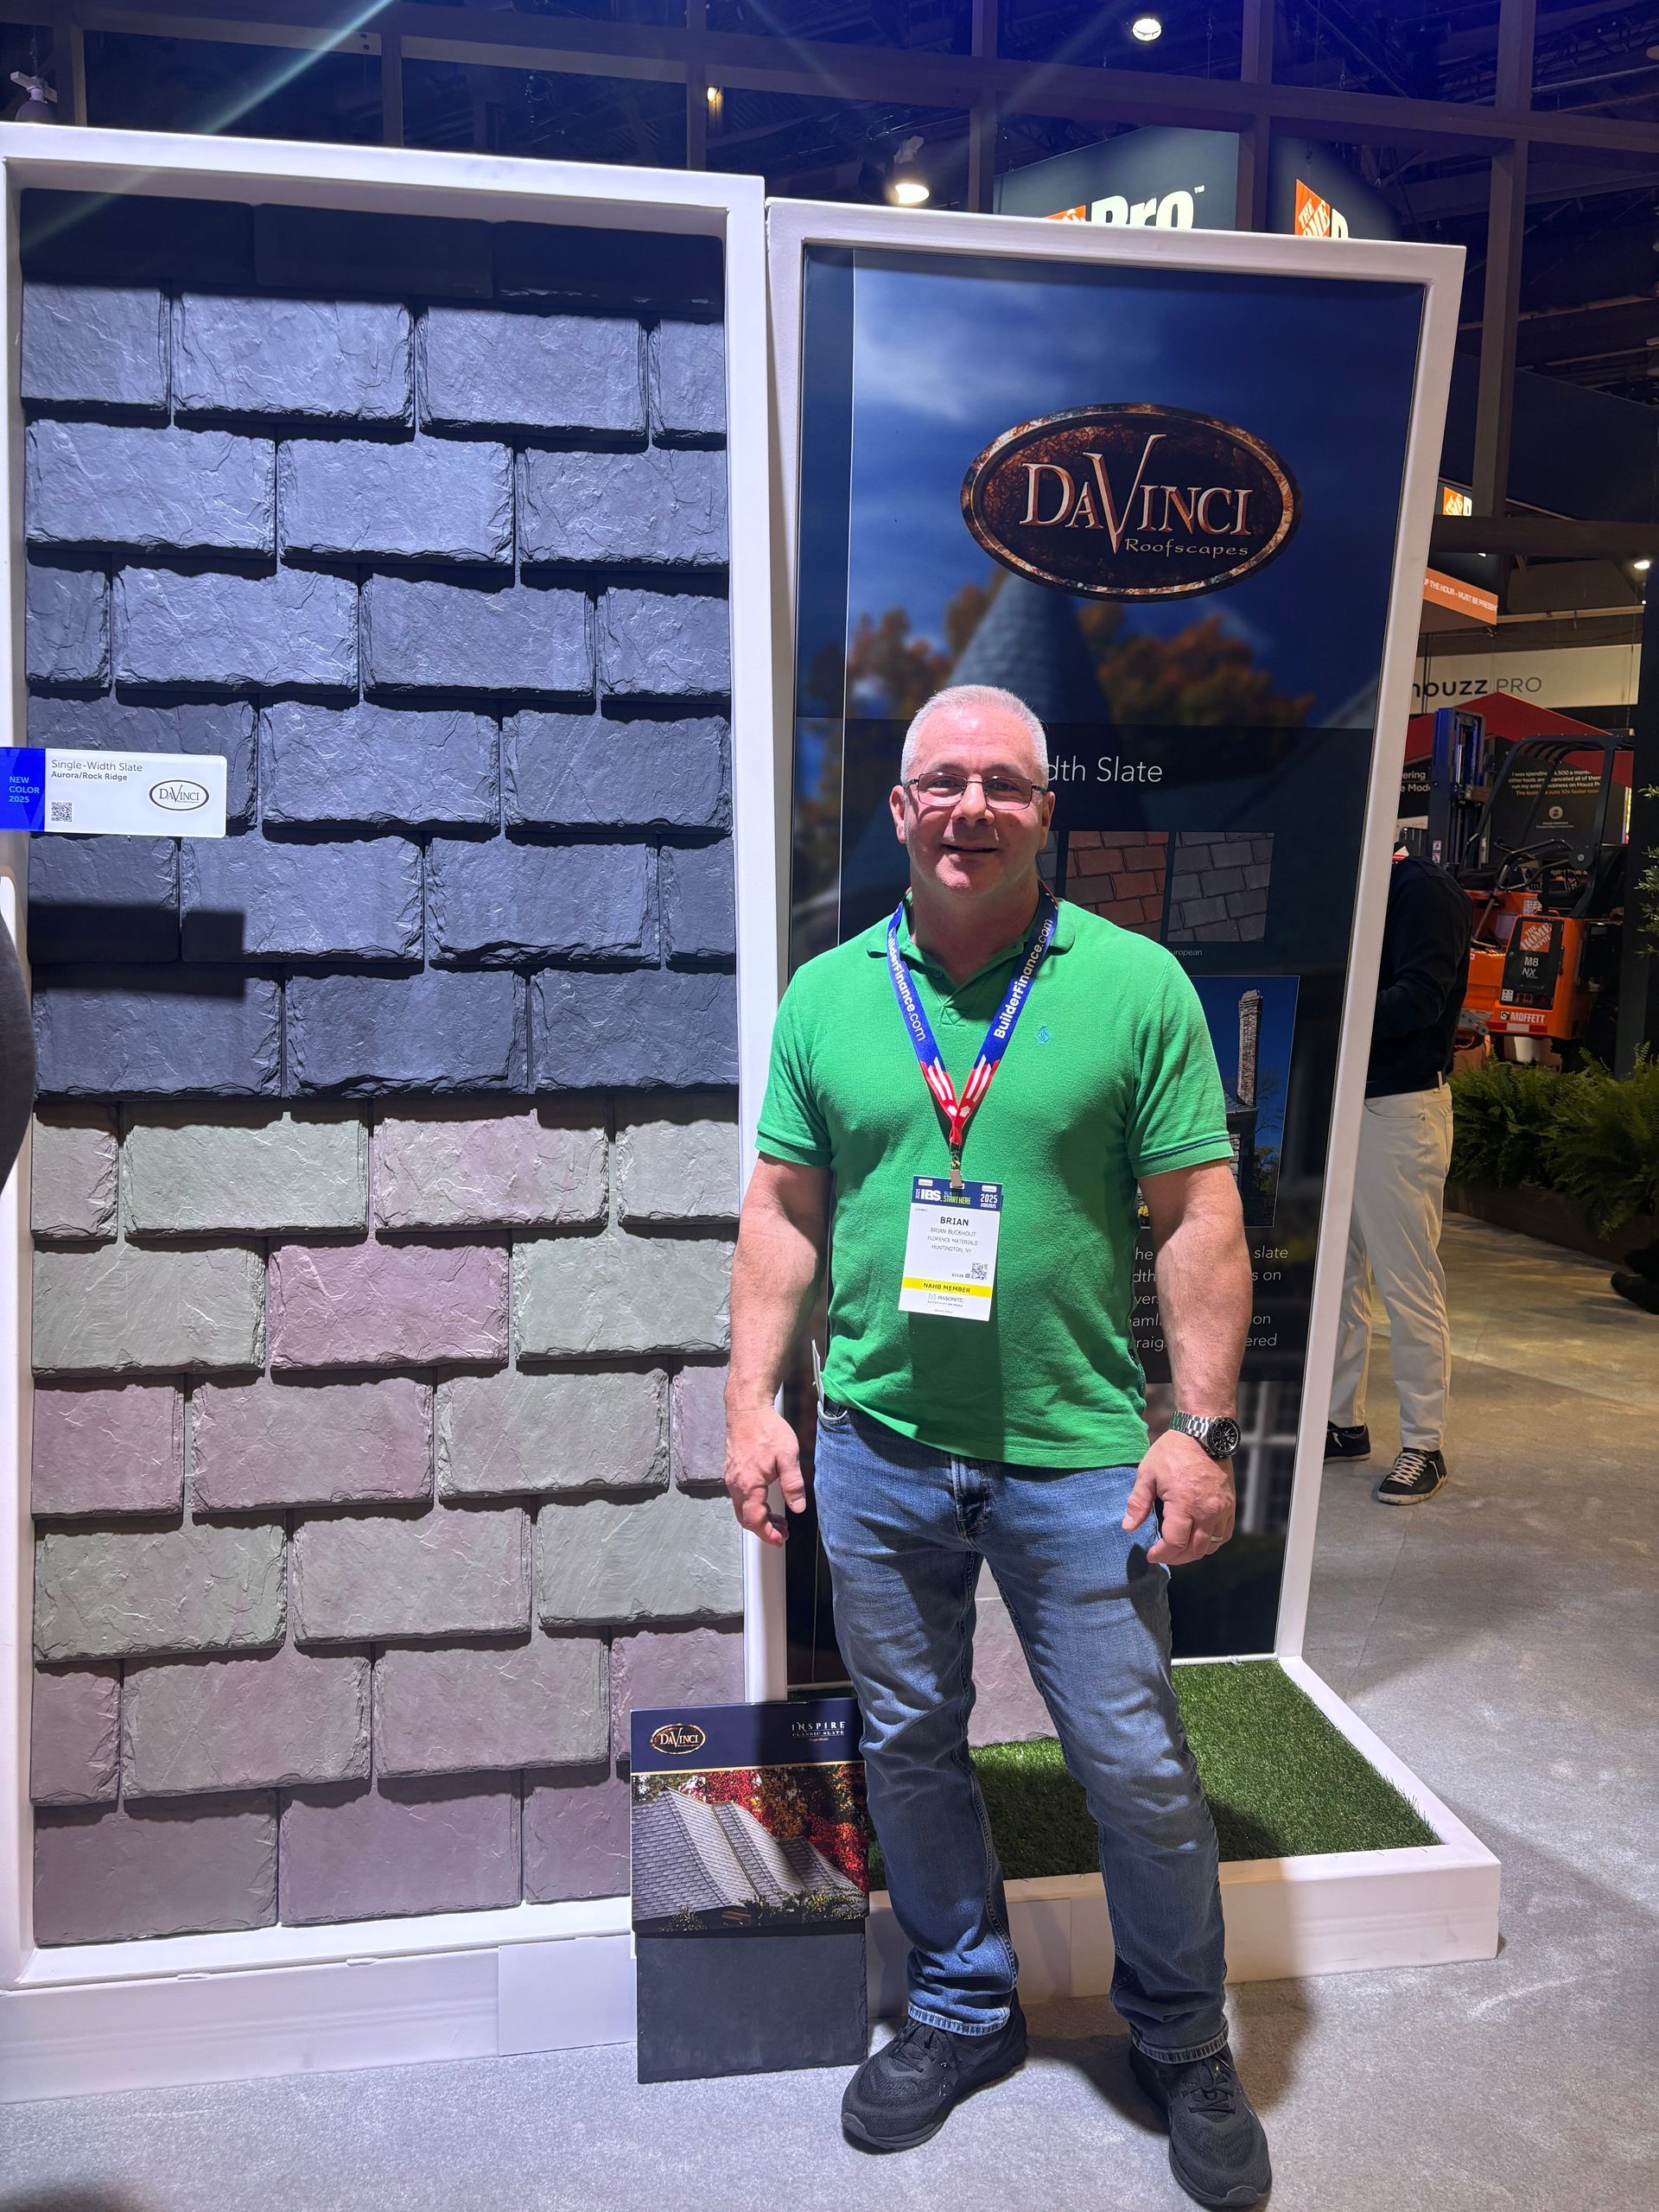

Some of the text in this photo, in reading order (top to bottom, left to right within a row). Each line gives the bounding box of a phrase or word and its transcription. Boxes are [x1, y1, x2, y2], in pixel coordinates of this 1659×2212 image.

[1125, 537, 1249, 558] Roofscapes
[1497, 677, 1542, 693] PRO
[51, 760, 143, 772] Single-Width Slate
[1096, 756, 1162, 782] Slate
[51, 771, 128, 781] Aurora/Rock Ridge
[9, 785, 40, 794] COLOR
[9, 795, 30, 804] 2025
[1170, 948, 1203, 957] uropean
[1524, 957, 1539, 967] M8
[993, 918, 1053, 1039] BuilderFinance.com
[1510, 1012, 1546, 1023] MOFFETT
[980, 1193, 998, 1204] 2025
[940, 1216, 969, 1226] BRIAN
[948, 1229, 976, 1237] BUCKHOUT
[1135, 1245, 1288, 1261] he slate
[1262, 1271, 1281, 1281] on
[943, 1285, 971, 1294] MEMBER
[791, 1721, 846, 1732] INSPIRE
